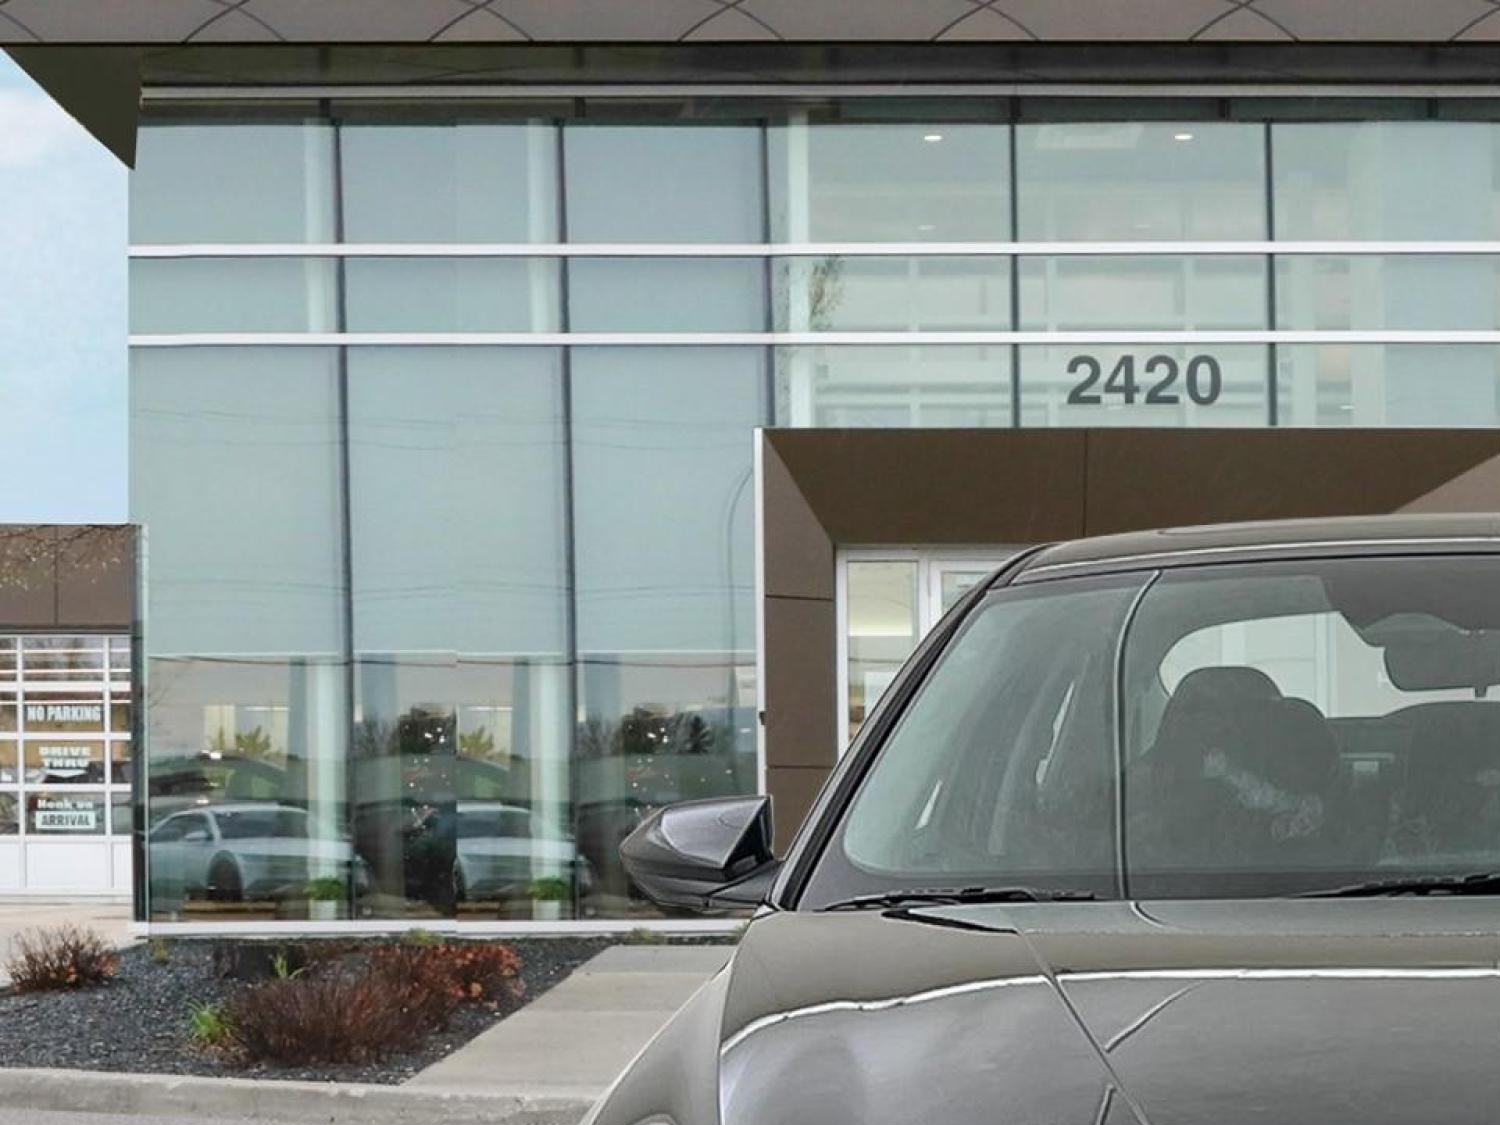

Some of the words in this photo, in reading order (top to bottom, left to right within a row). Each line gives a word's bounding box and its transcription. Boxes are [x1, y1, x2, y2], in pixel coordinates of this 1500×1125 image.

[1066, 354, 1223, 406] 2420
[27, 705, 45, 721] NO
[46, 705, 101, 721] PARKING
[41, 815, 90, 826] ARRIVAL
